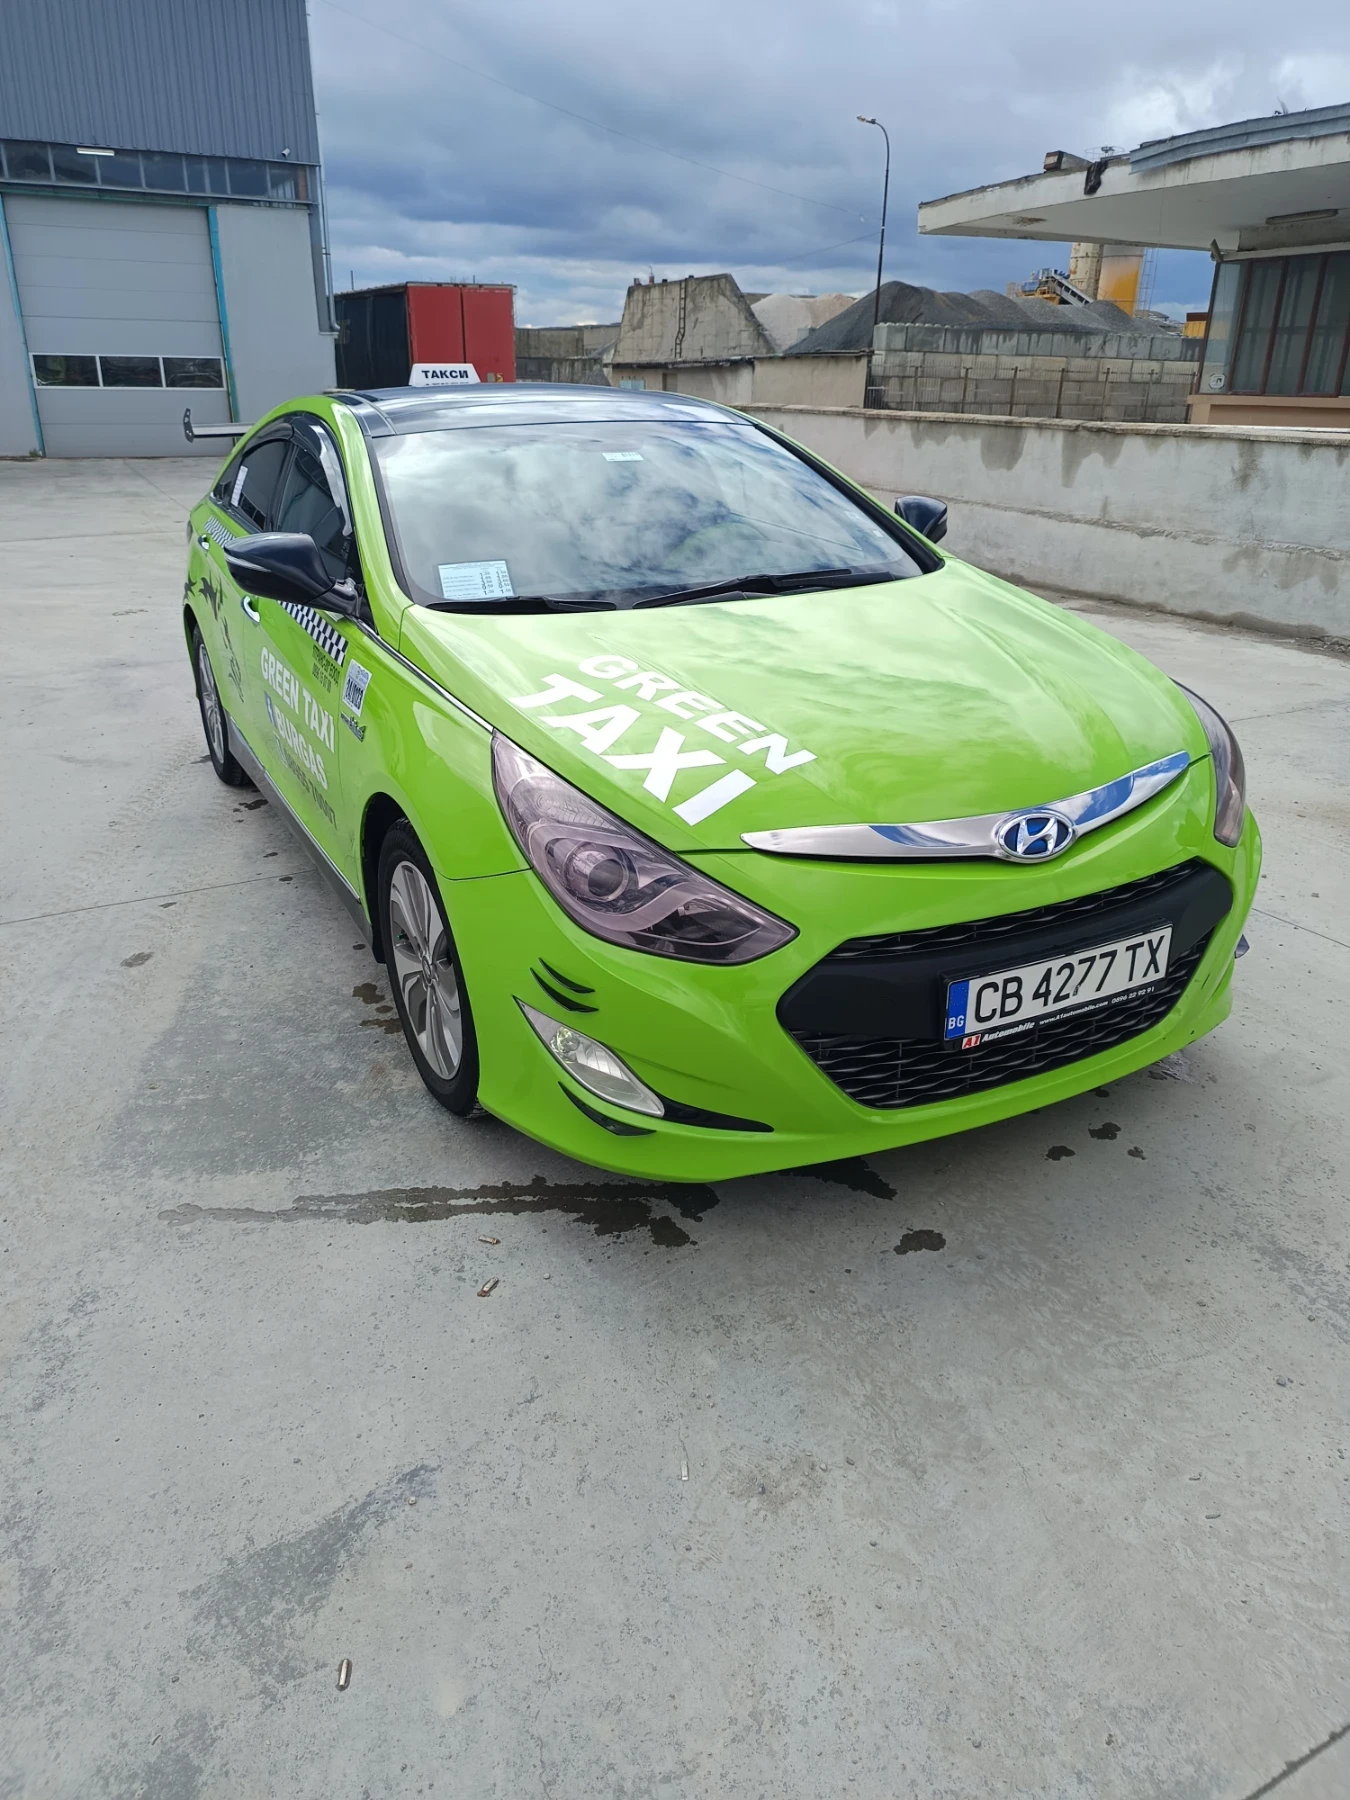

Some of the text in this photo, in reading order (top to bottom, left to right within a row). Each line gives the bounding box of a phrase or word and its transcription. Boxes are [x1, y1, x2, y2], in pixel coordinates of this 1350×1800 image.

[421, 369, 469, 379] ТАКСИ
[261, 646, 299, 715] GREEN
[302, 690, 335, 753] TAXI
[578, 654, 818, 775] GREEN
[274, 704, 328, 790] BURGAS
[507, 673, 758, 827] TAXI
[948, 1015, 965, 1030] BG
[974, 935, 1165, 1023] CB 4277 TX
[963, 1036, 980, 1049] A1
